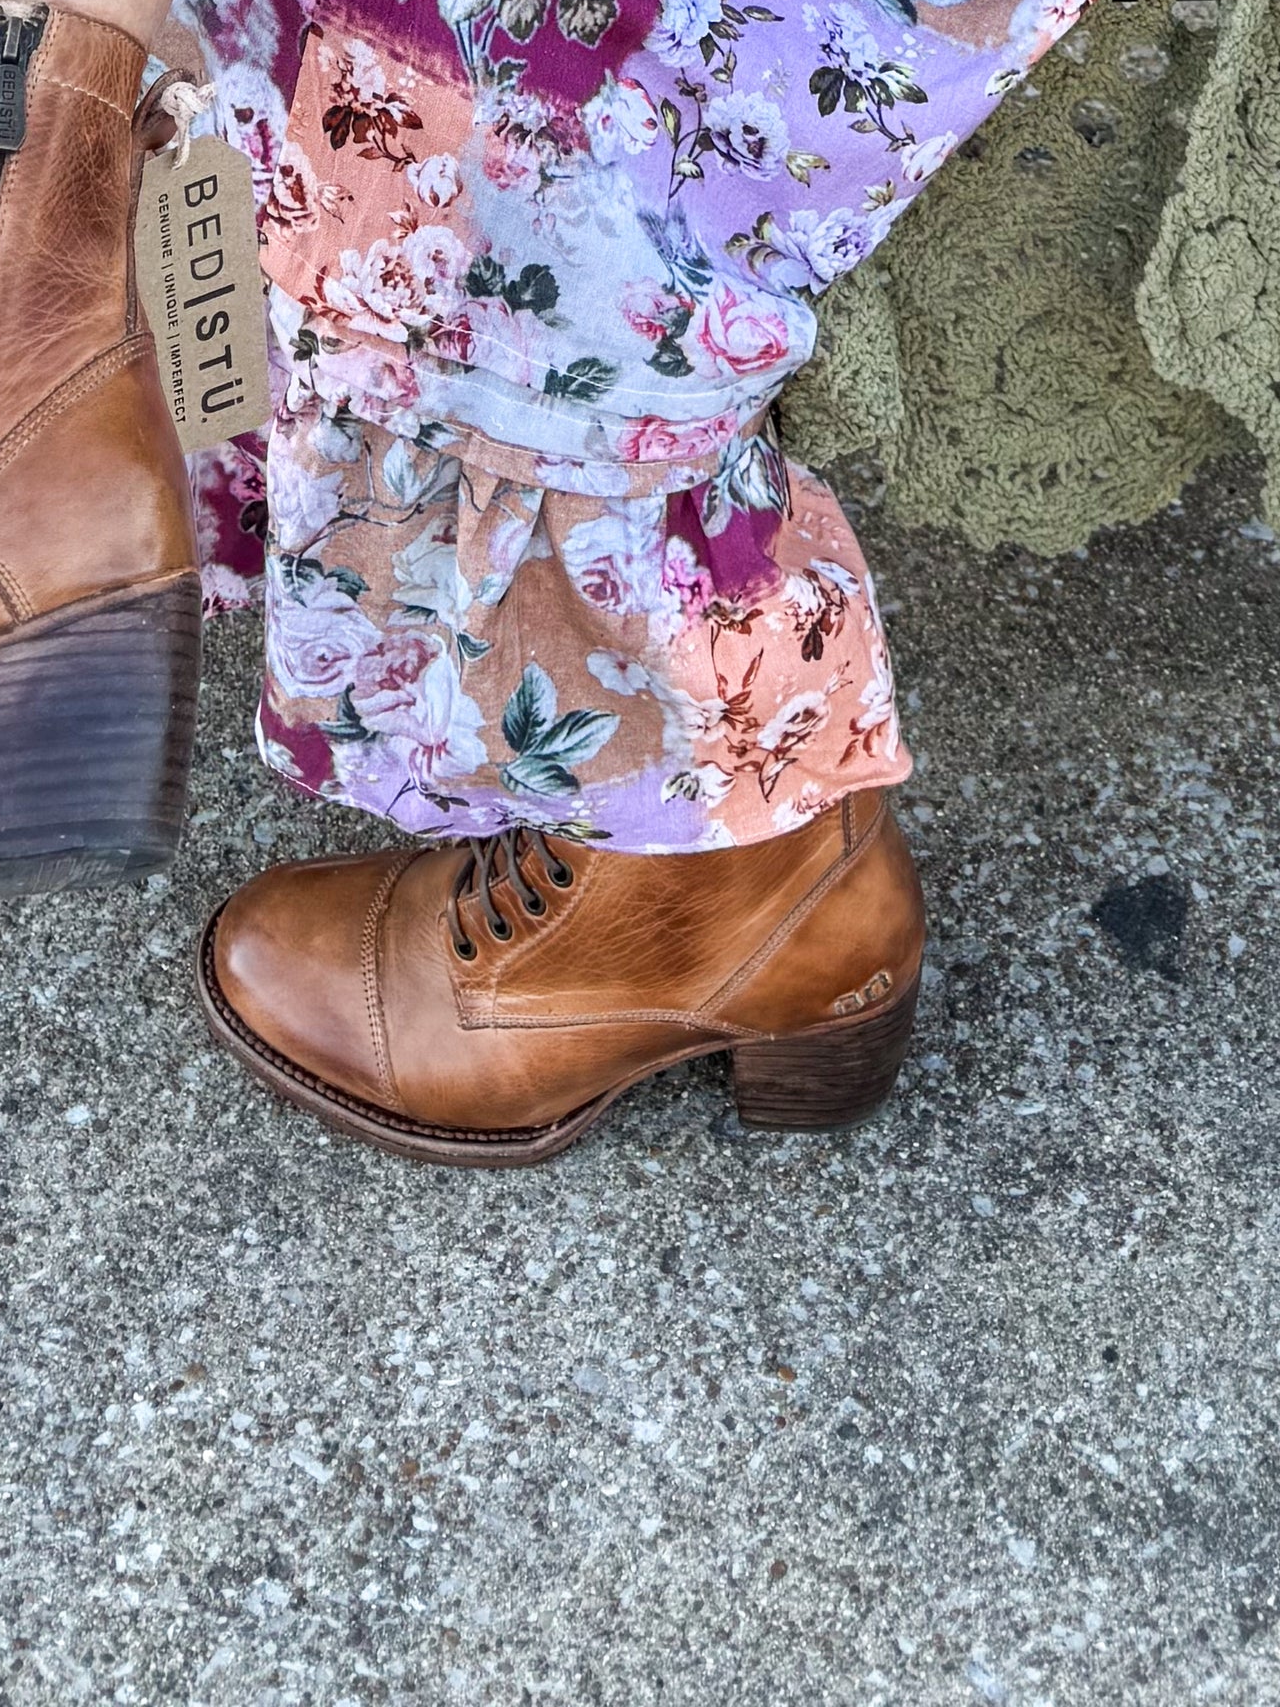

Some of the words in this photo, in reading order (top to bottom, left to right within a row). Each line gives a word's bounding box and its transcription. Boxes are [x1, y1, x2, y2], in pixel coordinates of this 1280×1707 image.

[158, 193, 173, 259] GENUINE
[164, 272, 179, 331] UNIQUE
[170, 343, 186, 423] IMPERFECT
